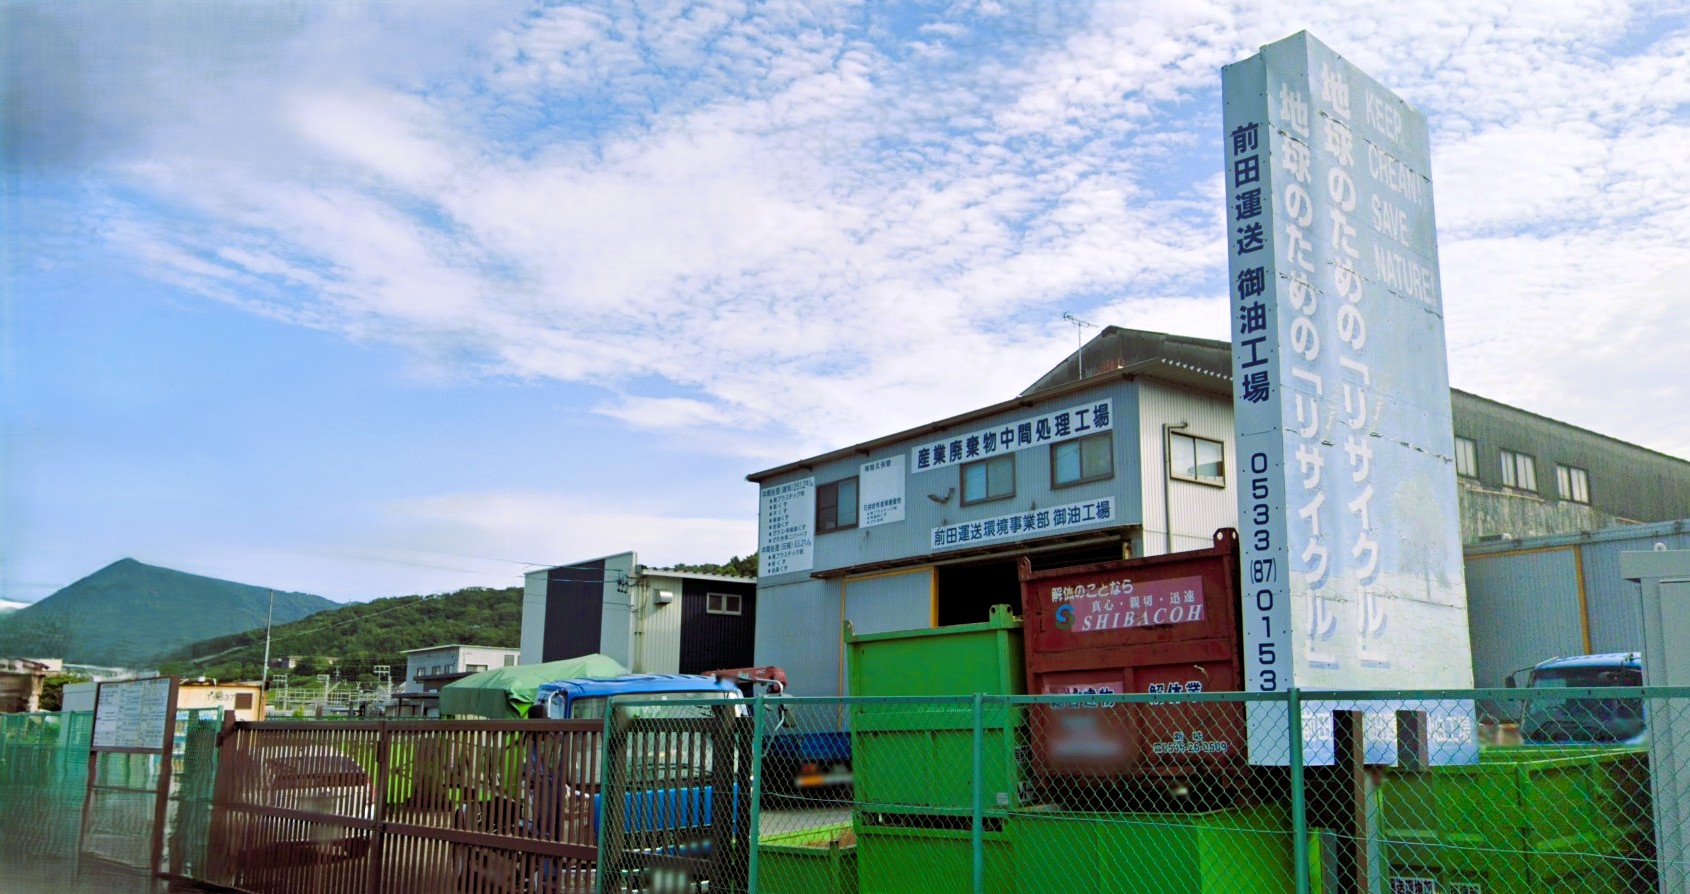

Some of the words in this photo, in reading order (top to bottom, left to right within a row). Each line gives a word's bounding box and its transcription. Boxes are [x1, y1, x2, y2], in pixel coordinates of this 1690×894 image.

[1365, 88, 1401, 142] KEEP
[1230, 122, 1264, 257] 前田運送
[1372, 193, 1410, 247] SAVE
[1237, 265, 1270, 404] 御油工場
[917, 403, 1110, 469] 産業廃棄物中間処理工場
[934, 511, 1050, 546] 前田運送環境事業部
[1053, 500, 1111, 527] 御油工場
[1250, 452, 1278, 692] 0533(87)0153
[1082, 604, 1204, 631] SHIBACOH
